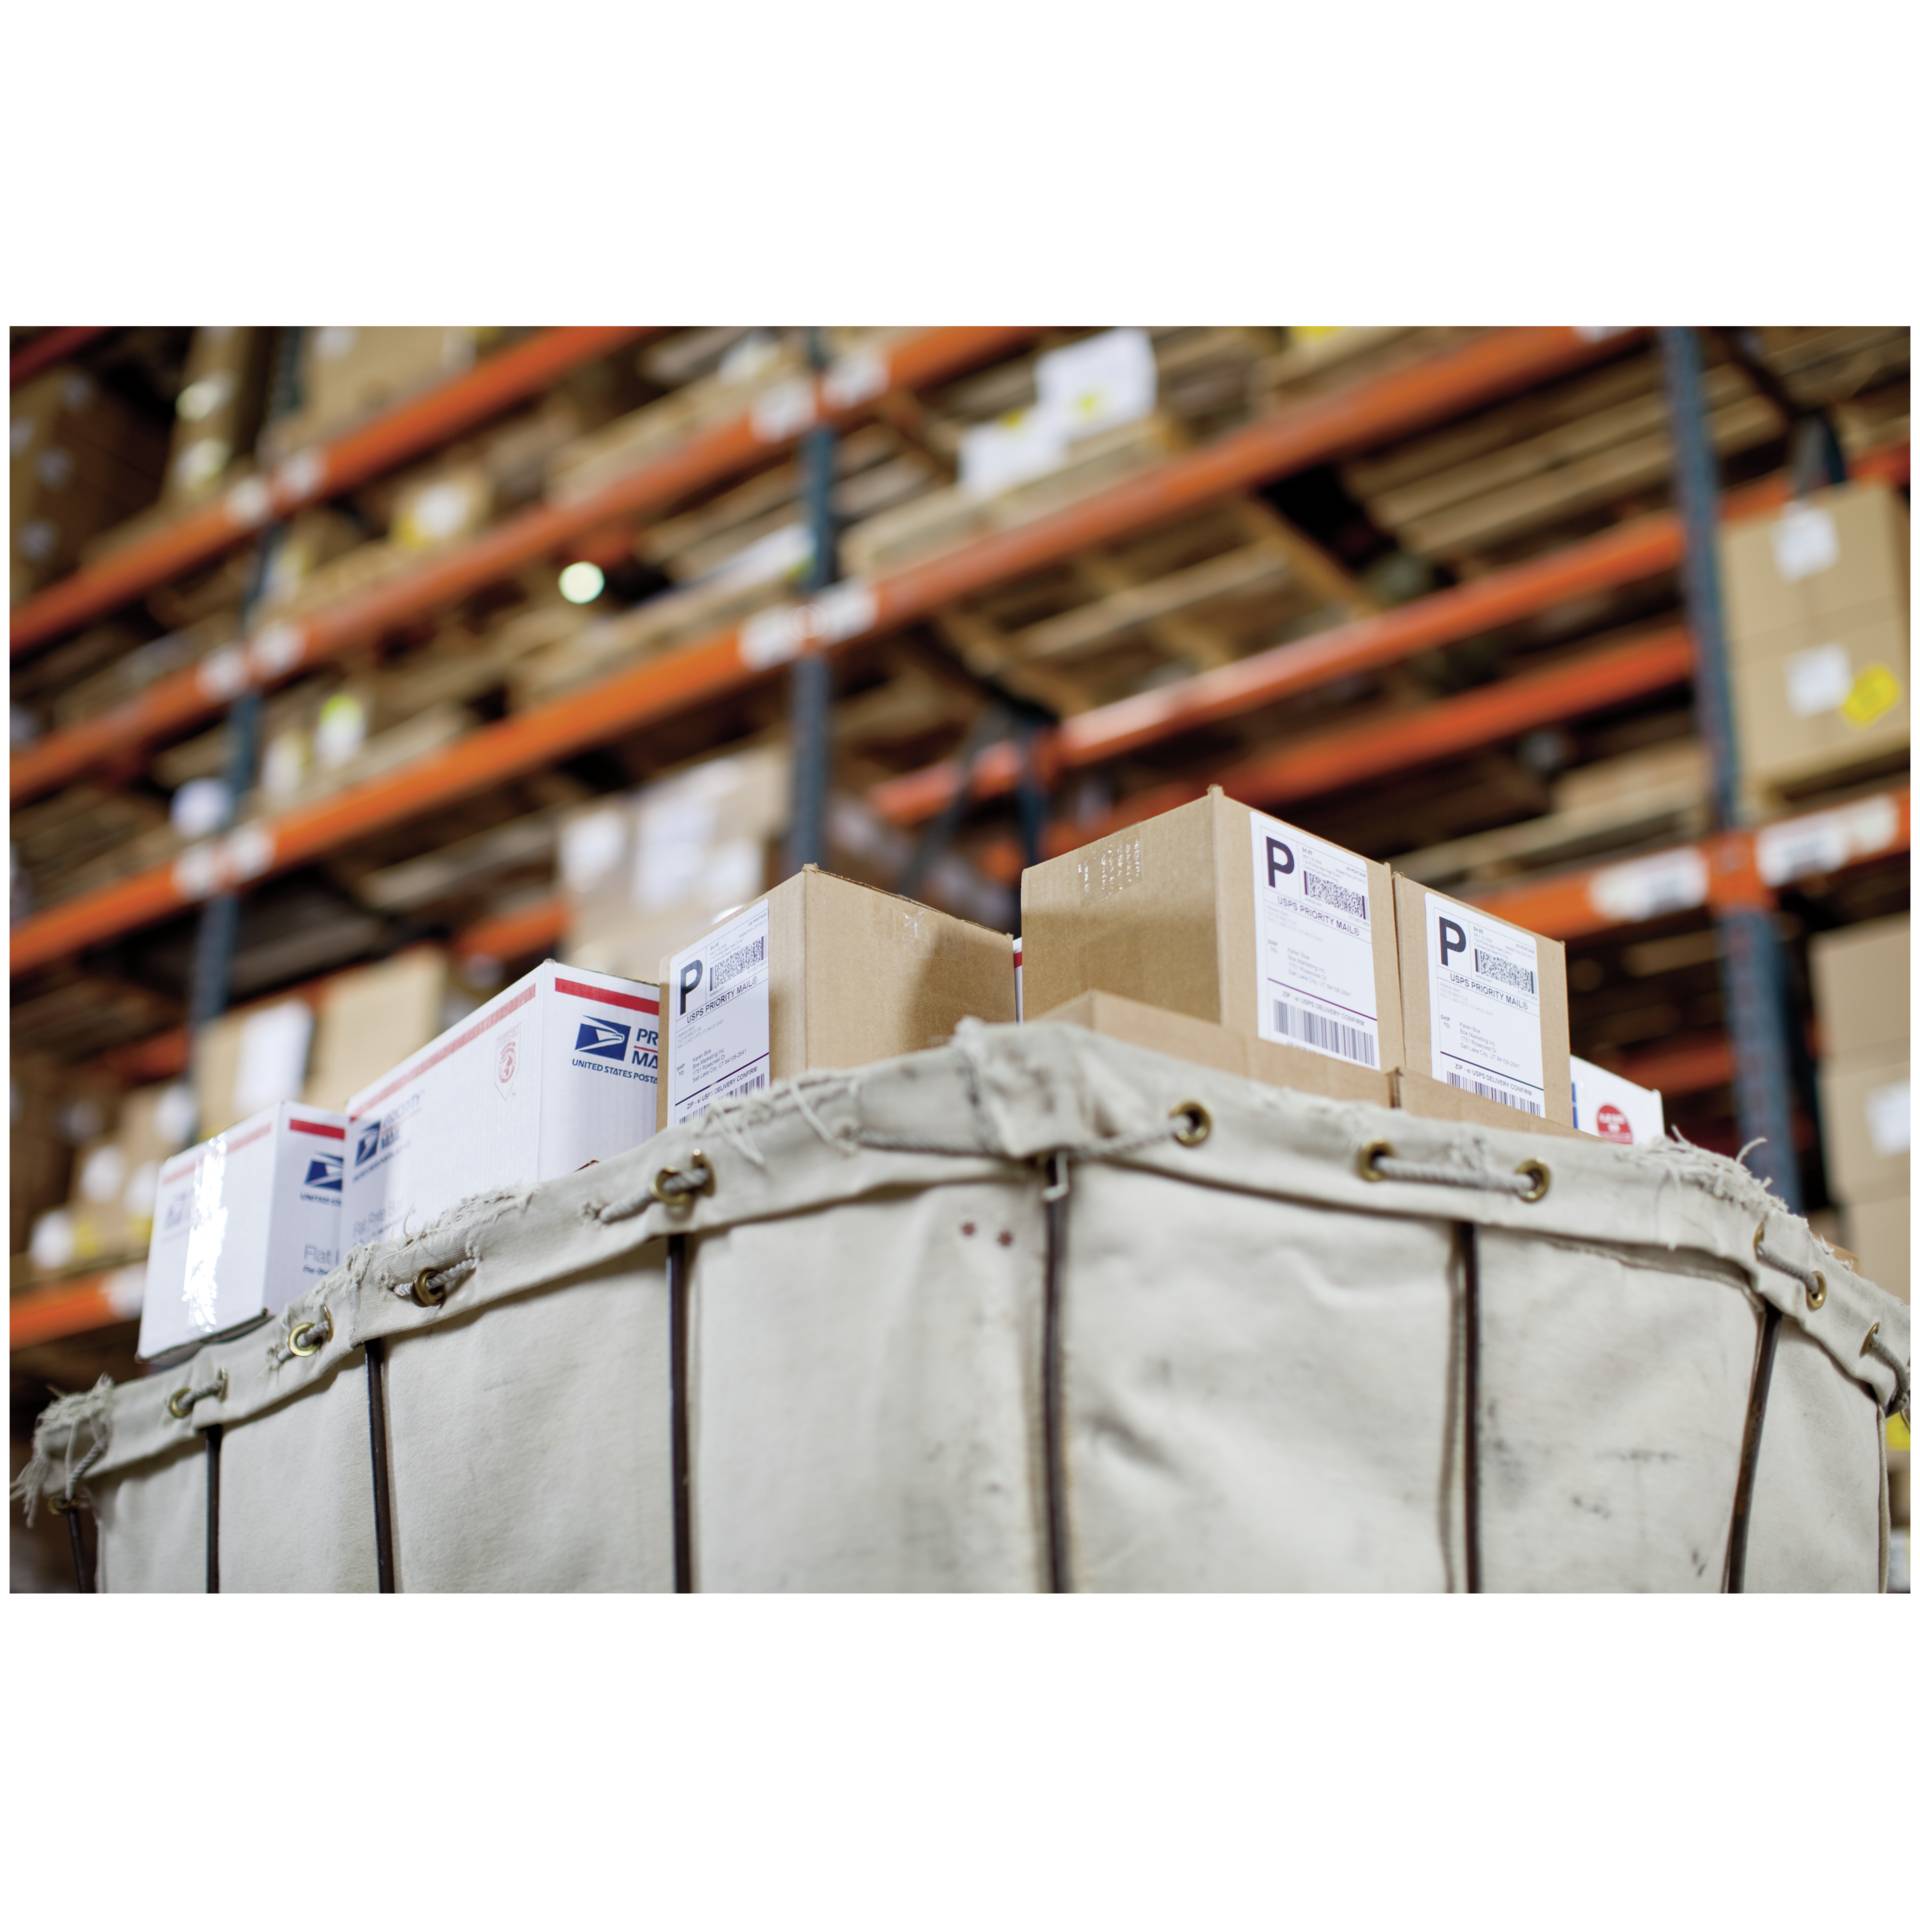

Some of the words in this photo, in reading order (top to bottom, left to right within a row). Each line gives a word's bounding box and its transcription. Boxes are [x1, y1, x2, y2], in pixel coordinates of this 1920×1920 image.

[1266, 836, 1295, 889] P
[1277, 895, 1298, 911] USPS
[1299, 904, 1335, 925] PRIORITY
[1438, 916, 1467, 967] P
[679, 959, 704, 1016] P
[1450, 972, 1470, 988] USPS
[1471, 981, 1505, 1001] PRIORITY
[686, 1007, 704, 1024] USPS
[705, 989, 735, 1013] PRIORITY
[571, 1058, 604, 1072] UNITED
[604, 1066, 632, 1079] STATES
[304, 1243, 332, 1265] Flat
